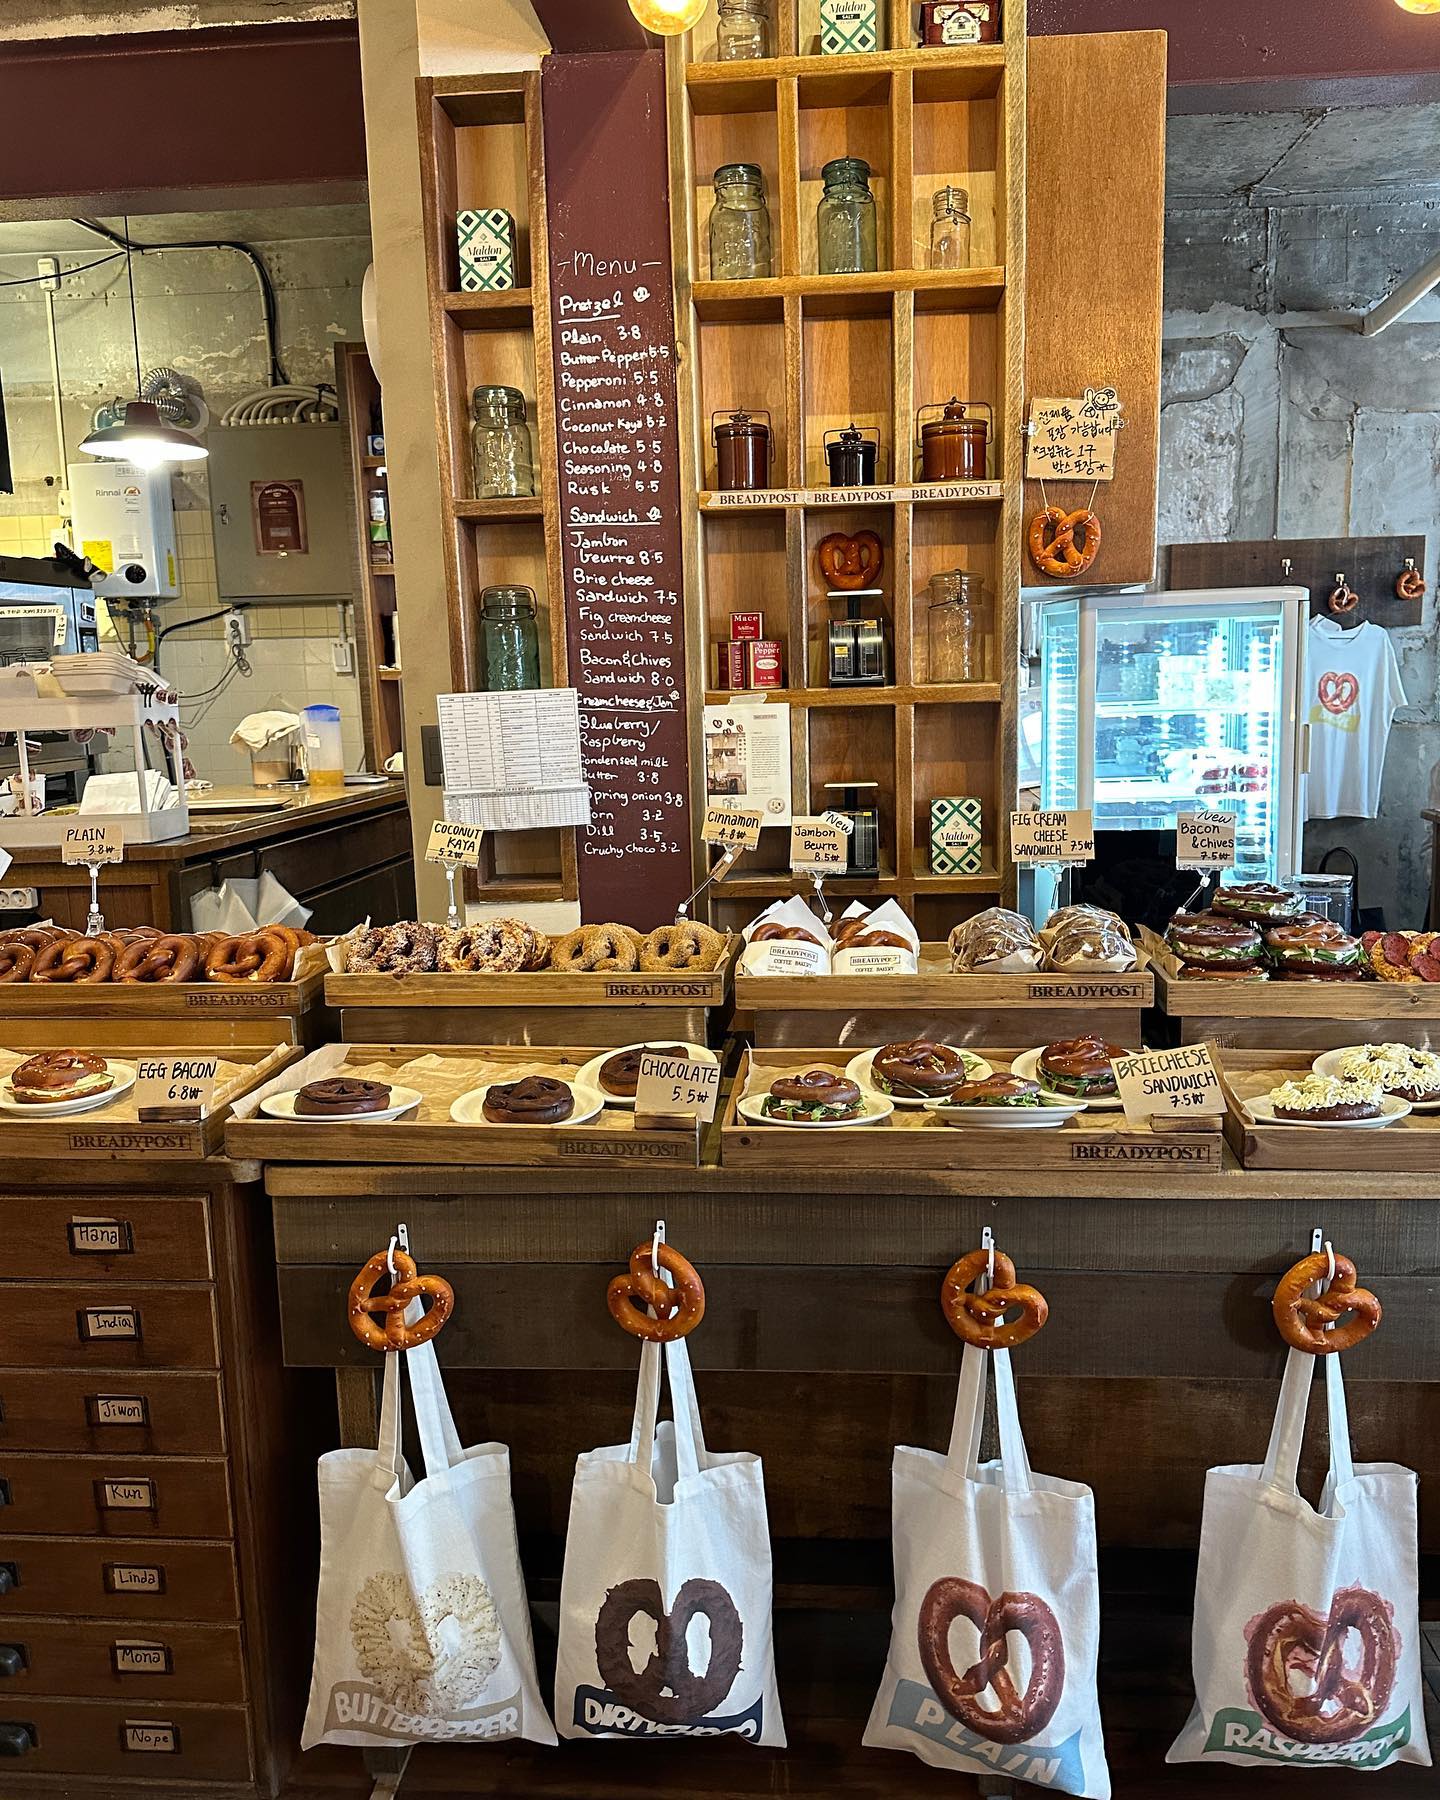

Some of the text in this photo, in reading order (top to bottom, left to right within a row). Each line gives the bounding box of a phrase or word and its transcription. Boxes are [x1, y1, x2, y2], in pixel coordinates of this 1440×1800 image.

[467, 245, 502, 256] Maldon
[560, 290, 624, 316] Pretzel
[561, 325, 641, 345] Plain 3.8
[601, 349, 648, 369] Pepper
[561, 371, 659, 392] Pepperoni 5.5
[561, 392, 664, 412] Cinnamon 4.8
[562, 417, 614, 433] Coconut
[617, 418, 643, 434] Kaya
[1046, 424, 1070, 441] 포장
[563, 438, 661, 455] Chocolate 5.5
[565, 460, 663, 478] Seasoning 4.8
[1052, 460, 1074, 474] 박스
[95, 489, 121, 497] Rinnai
[567, 480, 660, 496] Rusk 5.5
[913, 486, 993, 500] BREADYPOST
[719, 493, 799, 505] BREADYPOST
[813, 490, 894, 504] BREADYPOST
[570, 507, 638, 523] Sandwich
[570, 531, 628, 548] Jambon
[580, 548, 664, 565] beurre 8.5
[573, 568, 655, 586] Brie cheese
[576, 588, 678, 605] Sandwich 7.5
[579, 607, 604, 629] Fig
[580, 629, 673, 645] Sandwich 7.5
[733, 650, 742, 682] Cayenne
[584, 669, 675, 687] Sandwich 8.0
[580, 732, 646, 752] Raspberry
[637, 771, 659, 785] 3.8
[632, 789, 662, 802] onion
[664, 791, 684, 808] 3.8
[591, 808, 665, 821] orn 3.2
[1012, 812, 1067, 827] FIG CREAM
[1197, 809, 1232, 824] New
[434, 823, 482, 839] COCONUT
[794, 825, 836, 837] Jambon
[825, 813, 852, 834] New
[1181, 822, 1221, 834] Bacon
[66, 828, 106, 841] PLAIN
[586, 824, 663, 843] Dill 3.5
[940, 831, 975, 841] Maldon
[1034, 829, 1069, 842] CHEESE
[447, 836, 476, 852] KAYA
[584, 842, 624, 858] Cruchy
[660, 842, 681, 853] 3.2
[804, 840, 839, 851] Beurre
[1014, 844, 1062, 856] SANDWICH
[772, 948, 817, 960] BREADYPOST
[773, 958, 792, 966] COFFEE
[852, 956, 898, 964] BREADYPOT
[608, 983, 711, 997] BREADYPOST
[1031, 985, 1141, 998] BREADYPOST
[188, 994, 288, 1007] BREADYPOST
[138, 1061, 217, 1080] EGG BACON
[641, 1058, 719, 1084] CHOCOLATE
[1115, 1048, 1211, 1080] BRIECHEESE
[1142, 1070, 1218, 1095] SANDWICH
[71, 1135, 187, 1149] BREADYPOST
[564, 1142, 685, 1158] BREADYPOST
[1075, 1145, 1207, 1160] BREADYPOST
[79, 1225, 118, 1245] Hana
[101, 1401, 141, 1418] Jiwon
[110, 1484, 143, 1500] Kun
[119, 1570, 156, 1585] Linda
[121, 1649, 161, 1663] Mona
[334, 1691, 519, 1739] BUTTERPEPPER
[132, 1728, 169, 1747] Nope
[914, 1697, 1062, 1784] PLAIN
[1223, 1722, 1405, 1762] RASPBERRY
